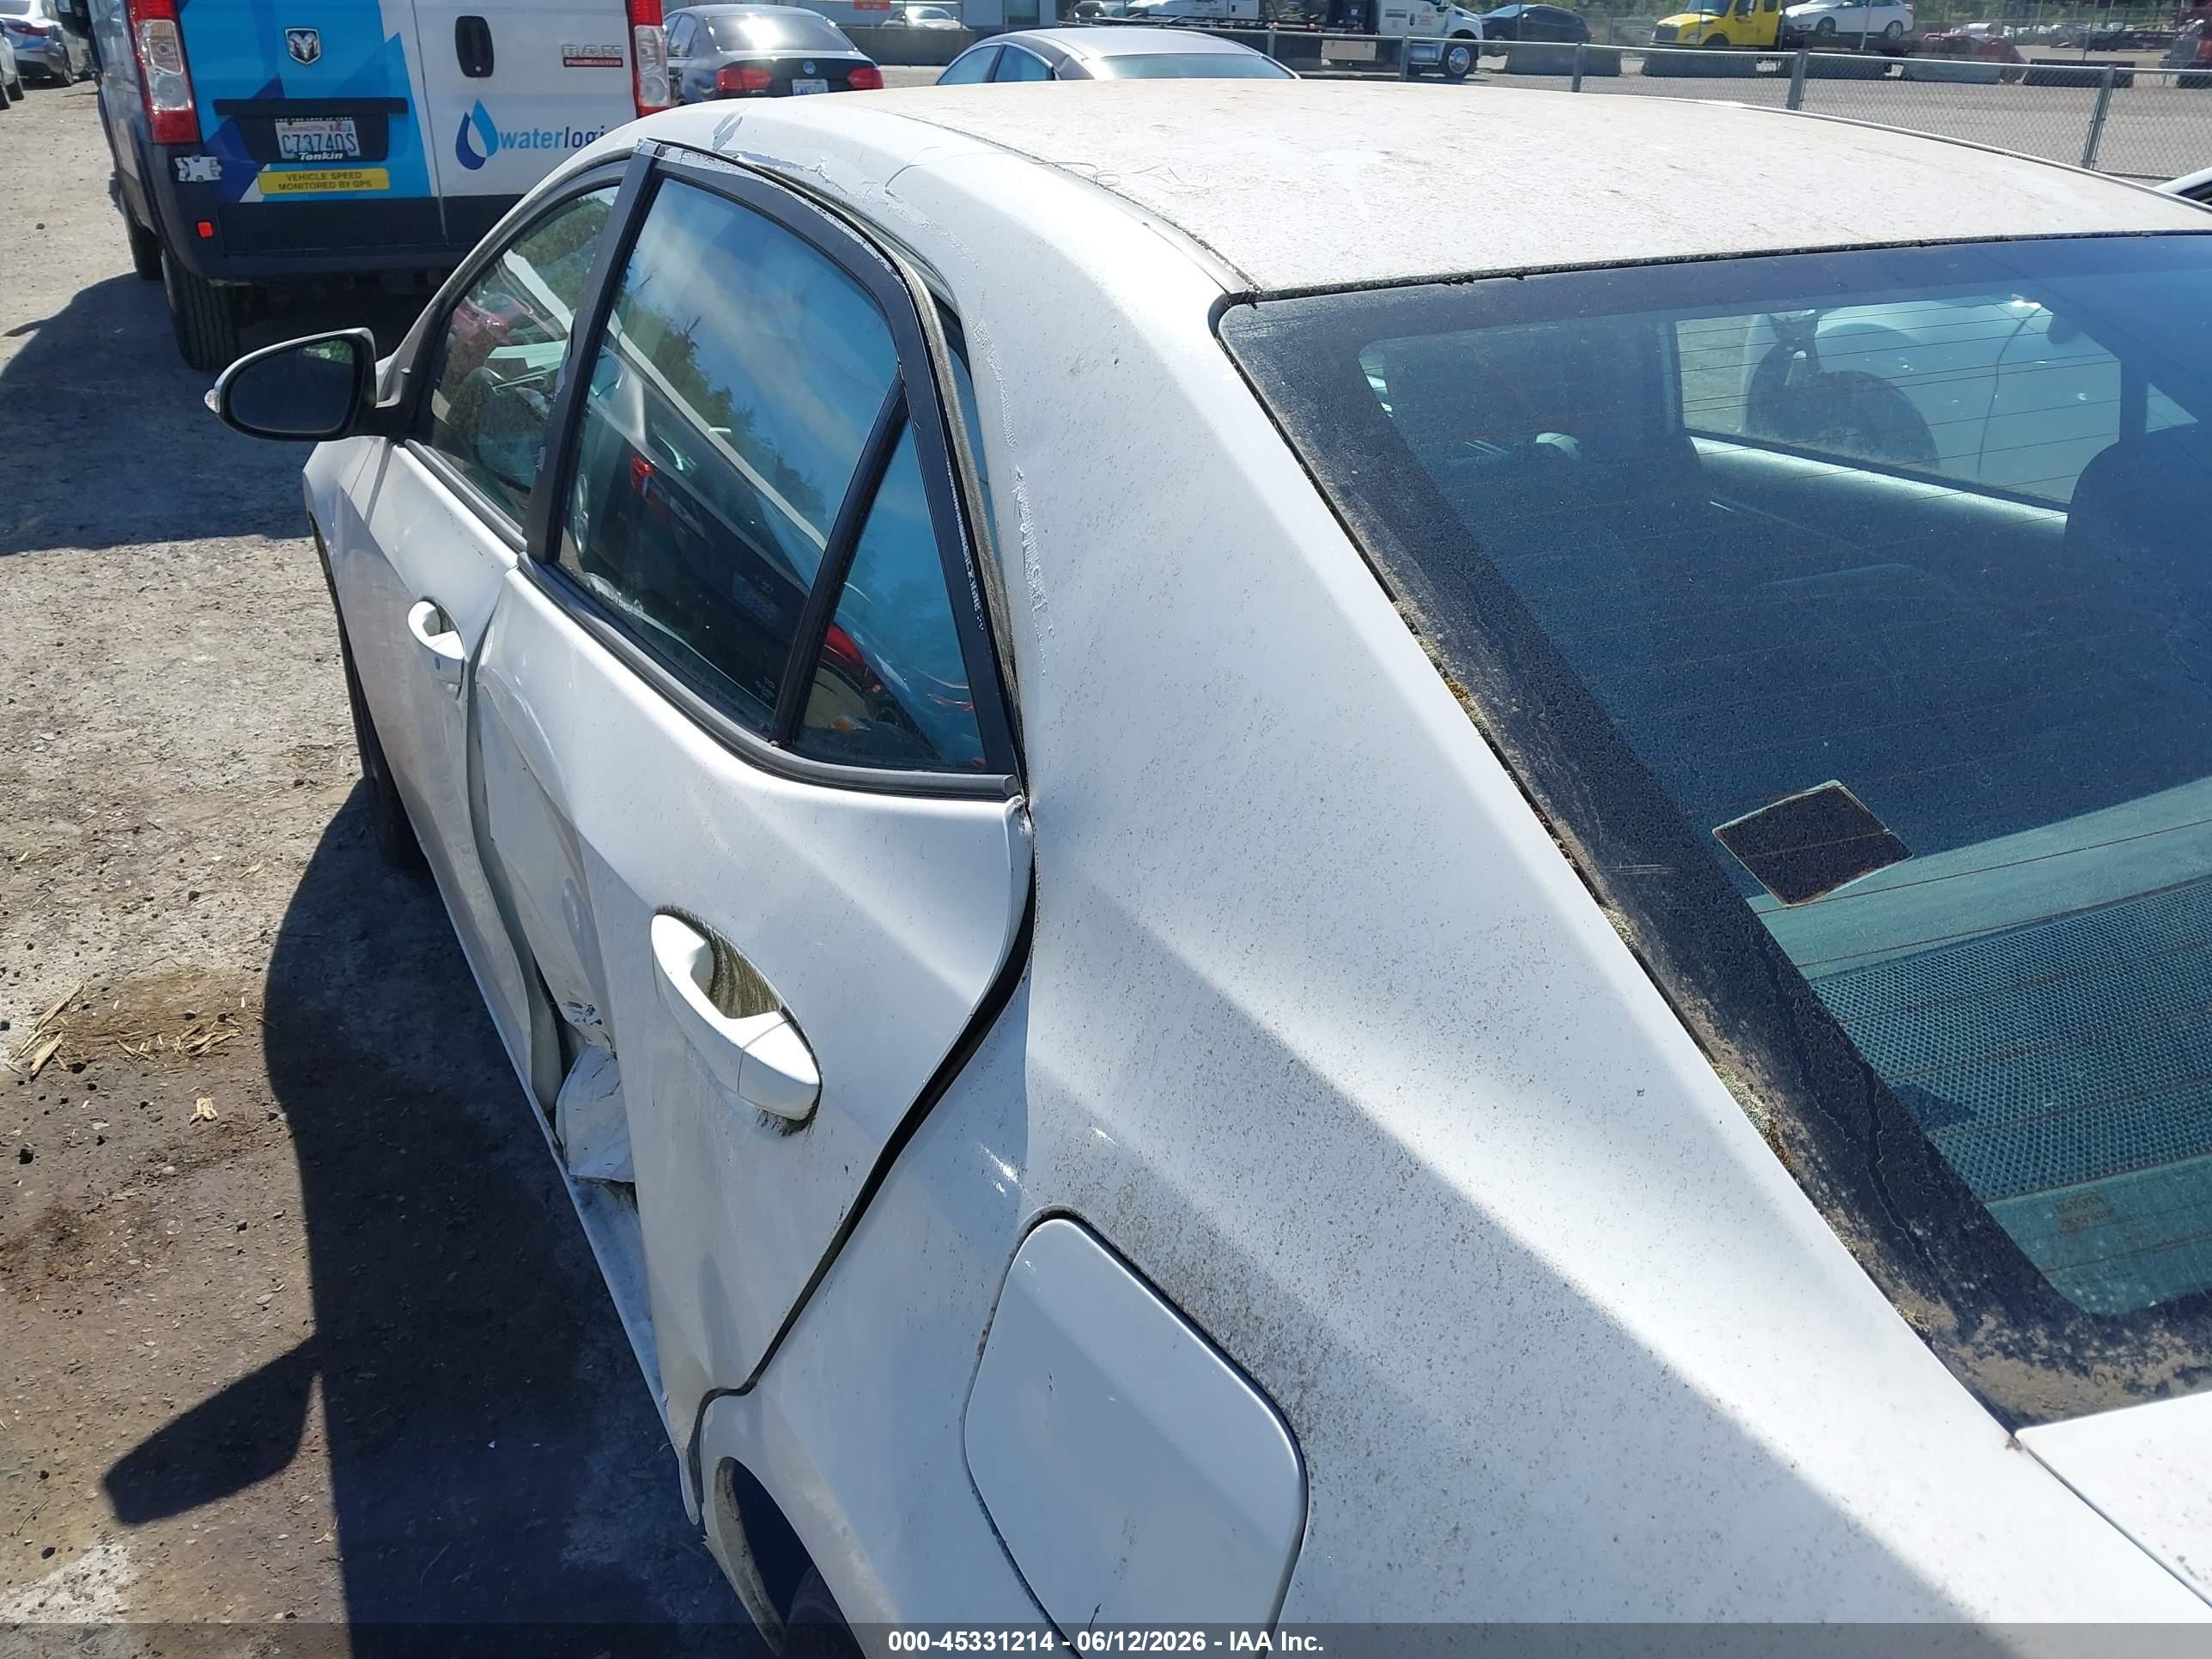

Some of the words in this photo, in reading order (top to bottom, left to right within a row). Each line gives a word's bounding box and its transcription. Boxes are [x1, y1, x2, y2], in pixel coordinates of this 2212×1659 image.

[299, 152, 343, 161] Tonkin
[286, 173, 327, 182] VEHICLE
[331, 172, 362, 180] SPEED
[278, 180, 337, 191] MONITORED
[353, 179, 372, 188] GPS
